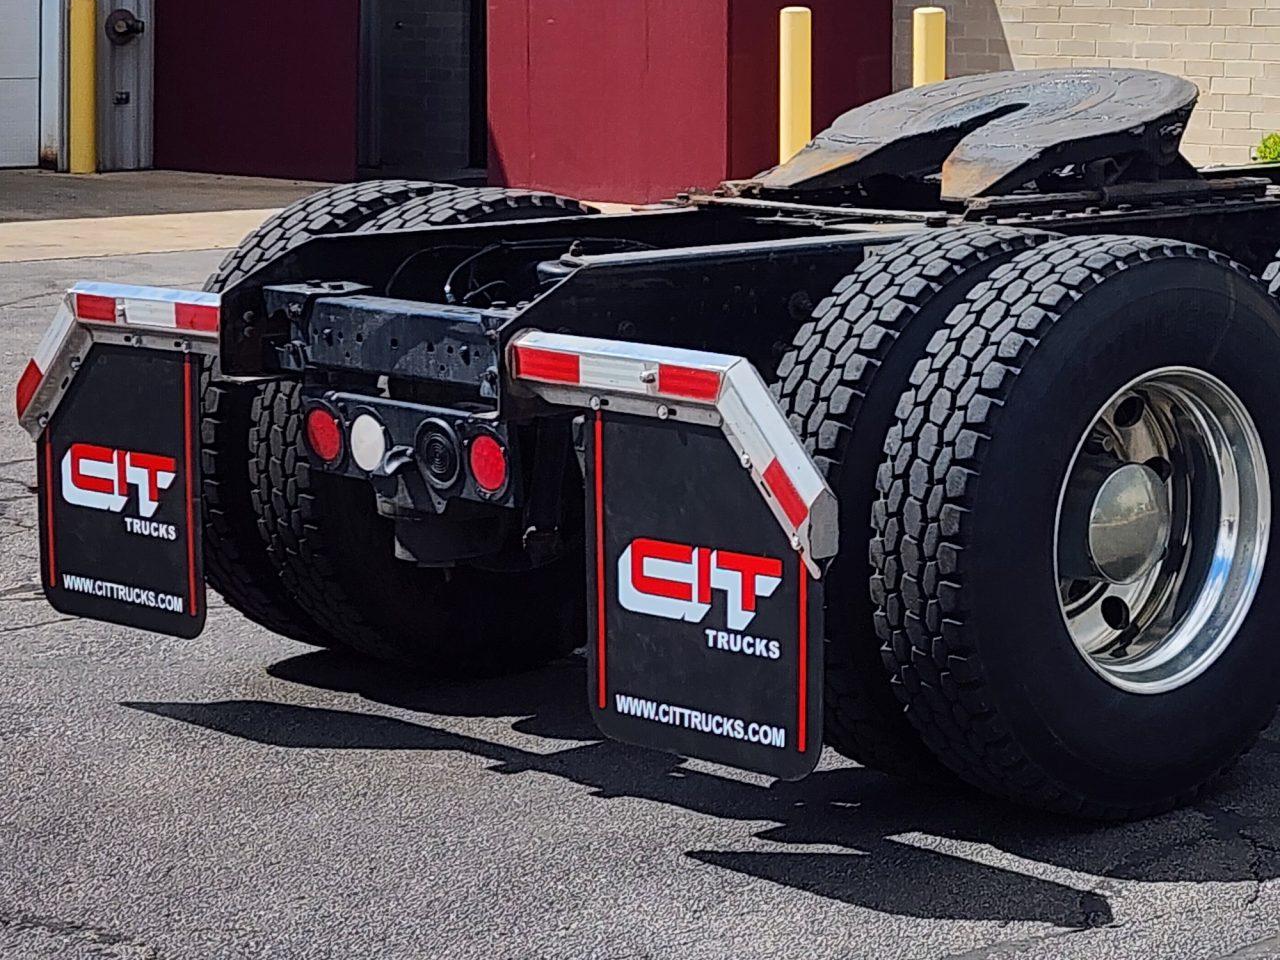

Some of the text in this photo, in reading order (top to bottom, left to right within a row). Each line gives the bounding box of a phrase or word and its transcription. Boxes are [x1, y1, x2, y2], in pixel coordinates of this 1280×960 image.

[61, 443, 176, 518] CIT
[124, 517, 177, 541] TRUCKS
[62, 574, 183, 613] WWW.CITTRUCKS.COM
[618, 537, 783, 631] CIT
[704, 628, 781, 660] TRUCKS
[615, 693, 786, 748] WWW.CITTRUCKS.COM
